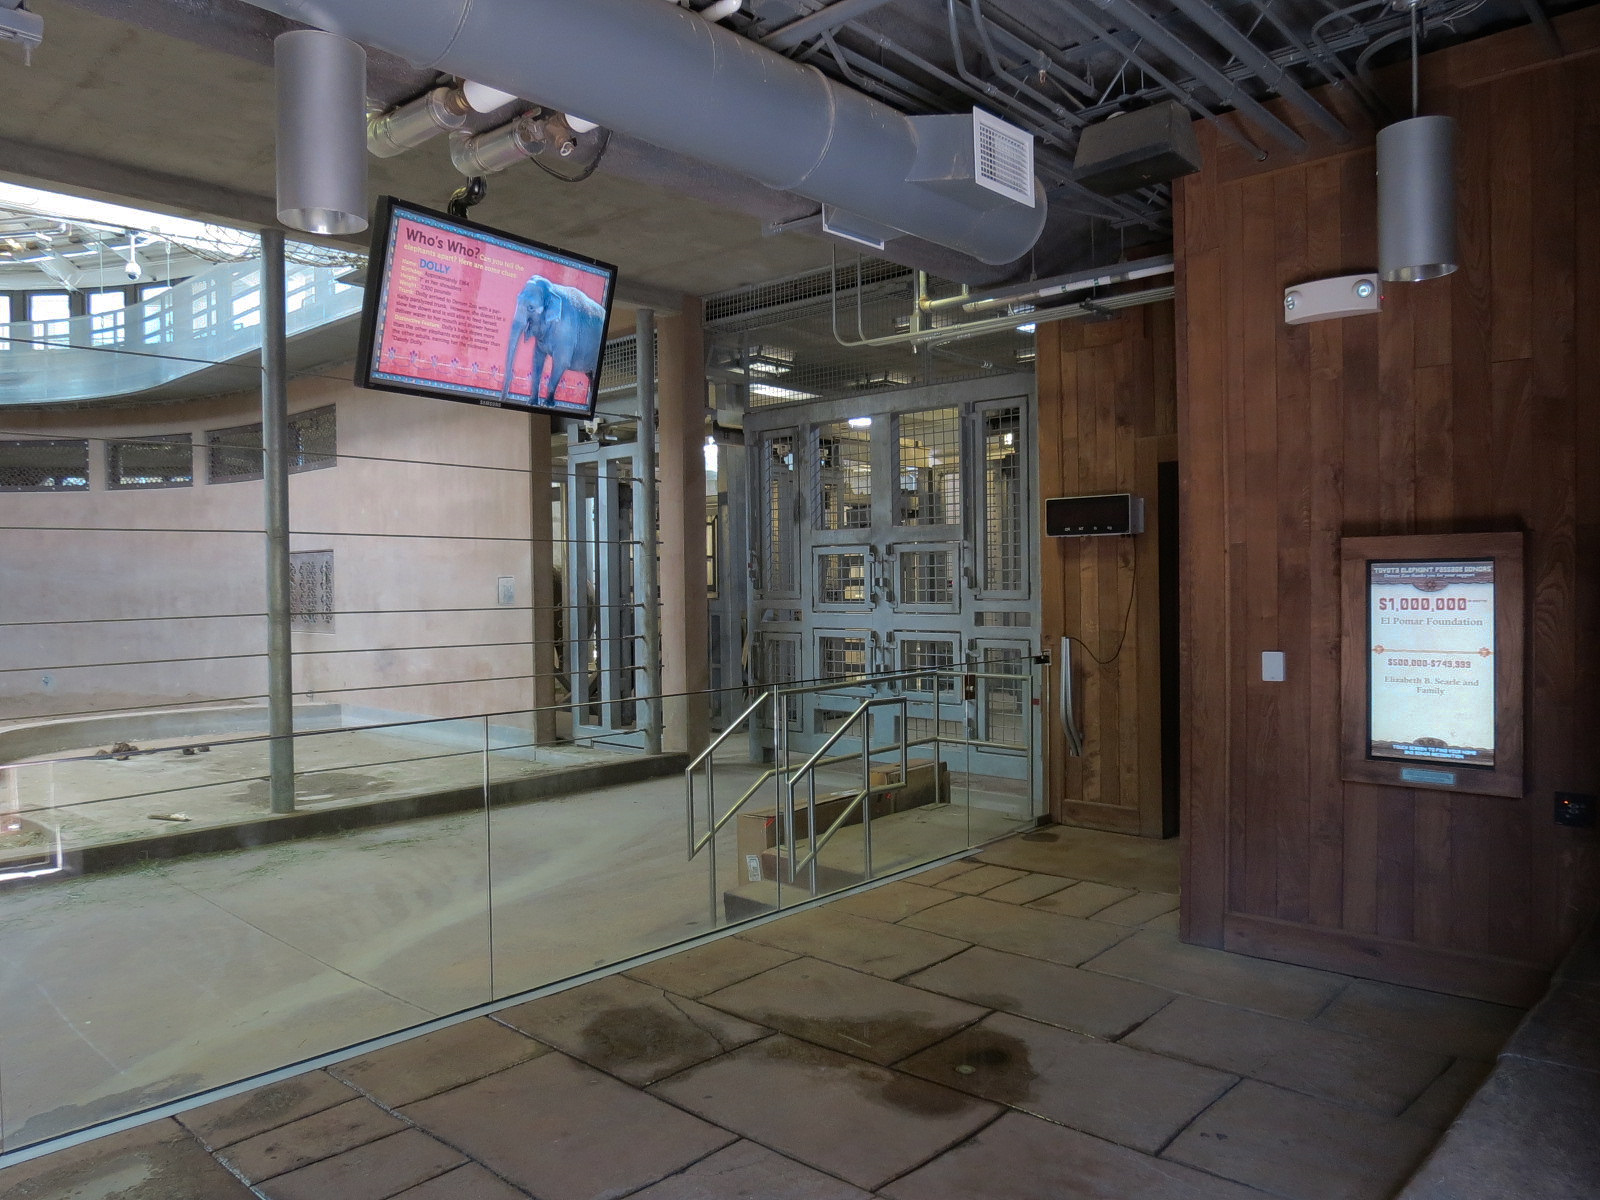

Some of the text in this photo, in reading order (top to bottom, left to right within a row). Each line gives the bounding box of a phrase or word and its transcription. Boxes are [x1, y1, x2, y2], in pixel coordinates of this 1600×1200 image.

[404, 243, 436, 257] elephants
[437, 252, 457, 263] apart?
[458, 258, 473, 267] Here
[406, 227, 444, 249] Who's
[447, 239, 480, 259] Who?
[480, 254, 491, 262] Can
[492, 258, 503, 267] you
[514, 264, 525, 272] the
[419, 258, 451, 274] DOLLY
[416, 290, 428, 298] Dolly
[1379, 598, 1467, 612] $1,000,000
[1381, 617, 1483, 626] El Pomar Foundation
[1384, 675, 1422, 684] Elizabeth
[1462, 679, 1479, 687] and
[1416, 686, 1446, 696] Family
